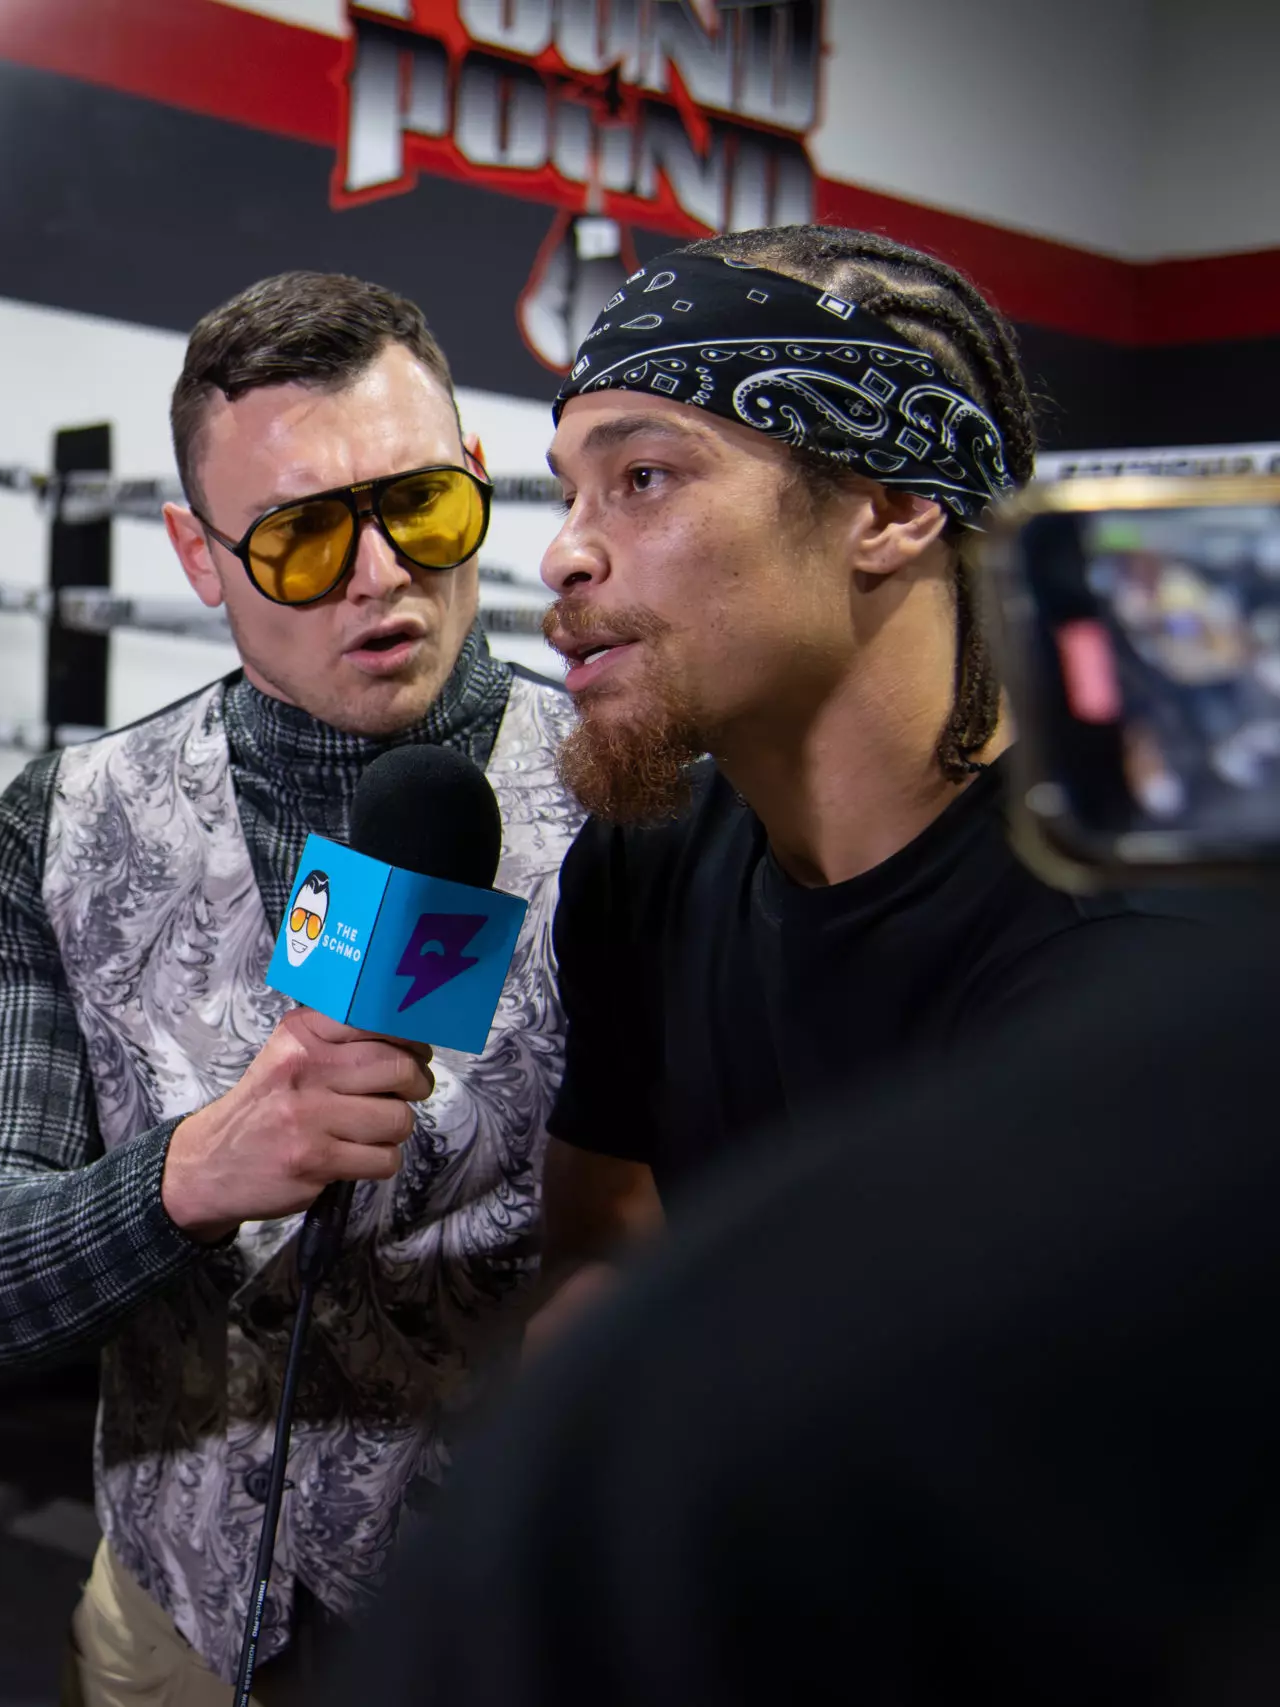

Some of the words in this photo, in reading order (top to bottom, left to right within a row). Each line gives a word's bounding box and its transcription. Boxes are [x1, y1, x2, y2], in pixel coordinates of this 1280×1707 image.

[350, 0, 818, 131] UND
[346, 20, 818, 234] POUND
[322, 934, 361, 961] SCHMO
[336, 921, 358, 942] THE
